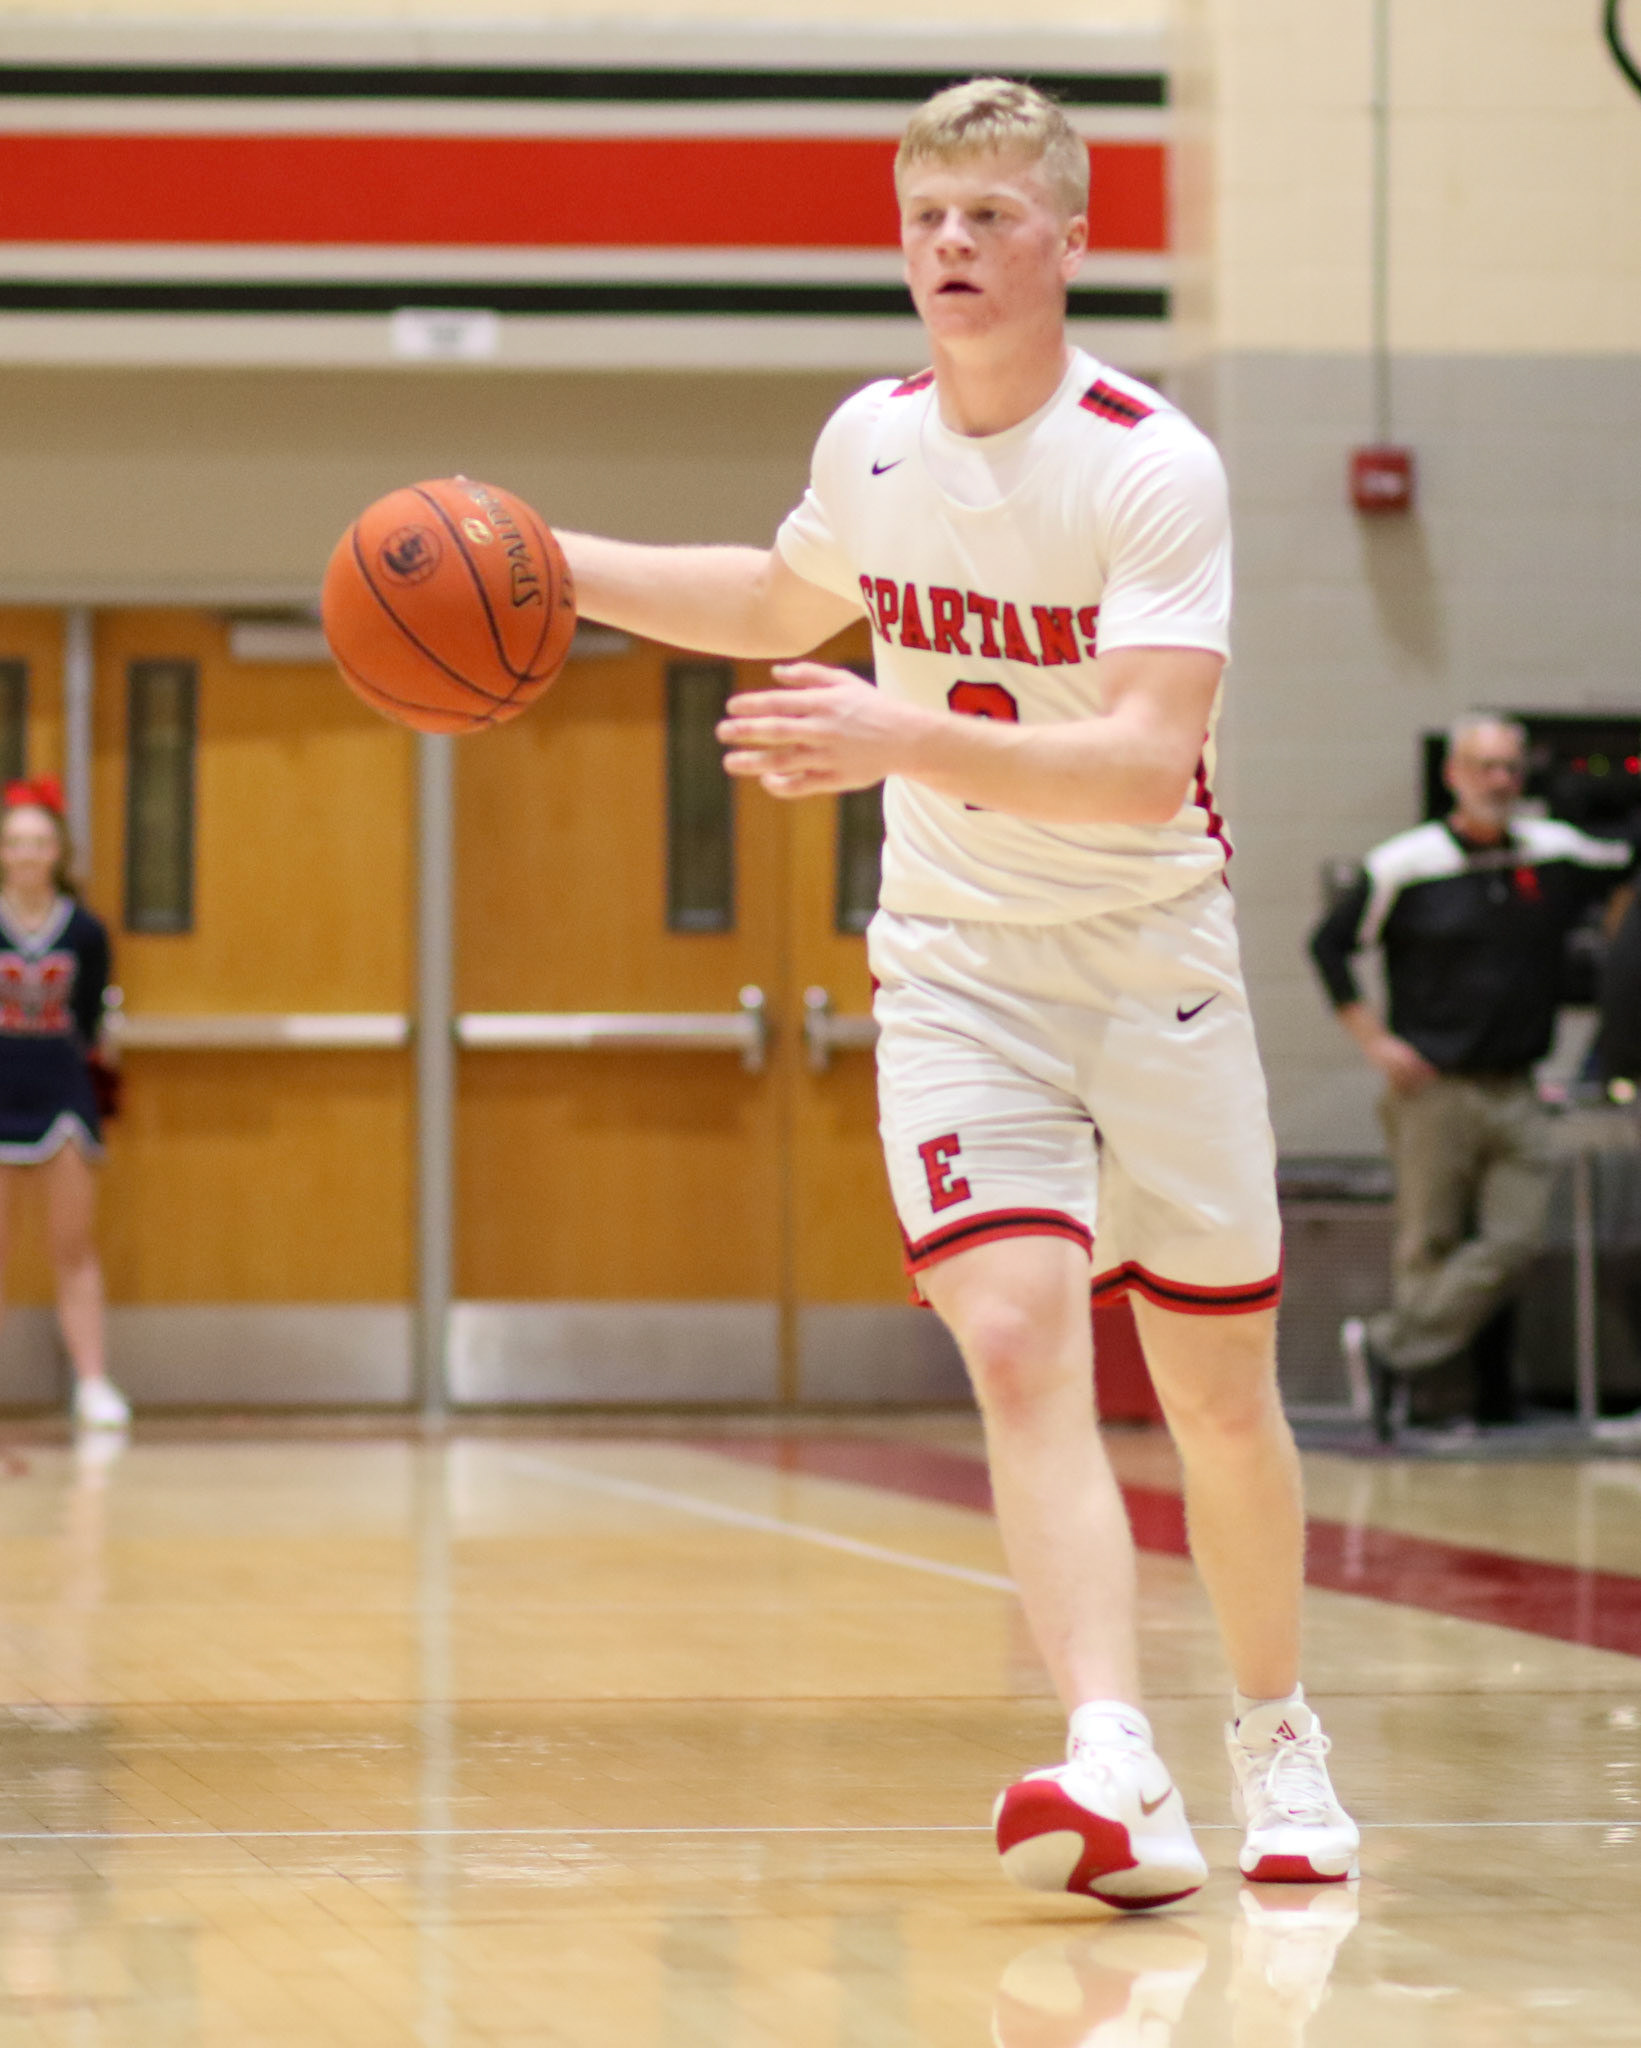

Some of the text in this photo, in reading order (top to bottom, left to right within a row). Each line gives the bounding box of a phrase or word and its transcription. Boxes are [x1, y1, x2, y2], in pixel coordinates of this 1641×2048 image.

[468, 486, 542, 607] SPALD
[859, 574, 1099, 666] SPARTANS
[918, 1133, 972, 1214] E
